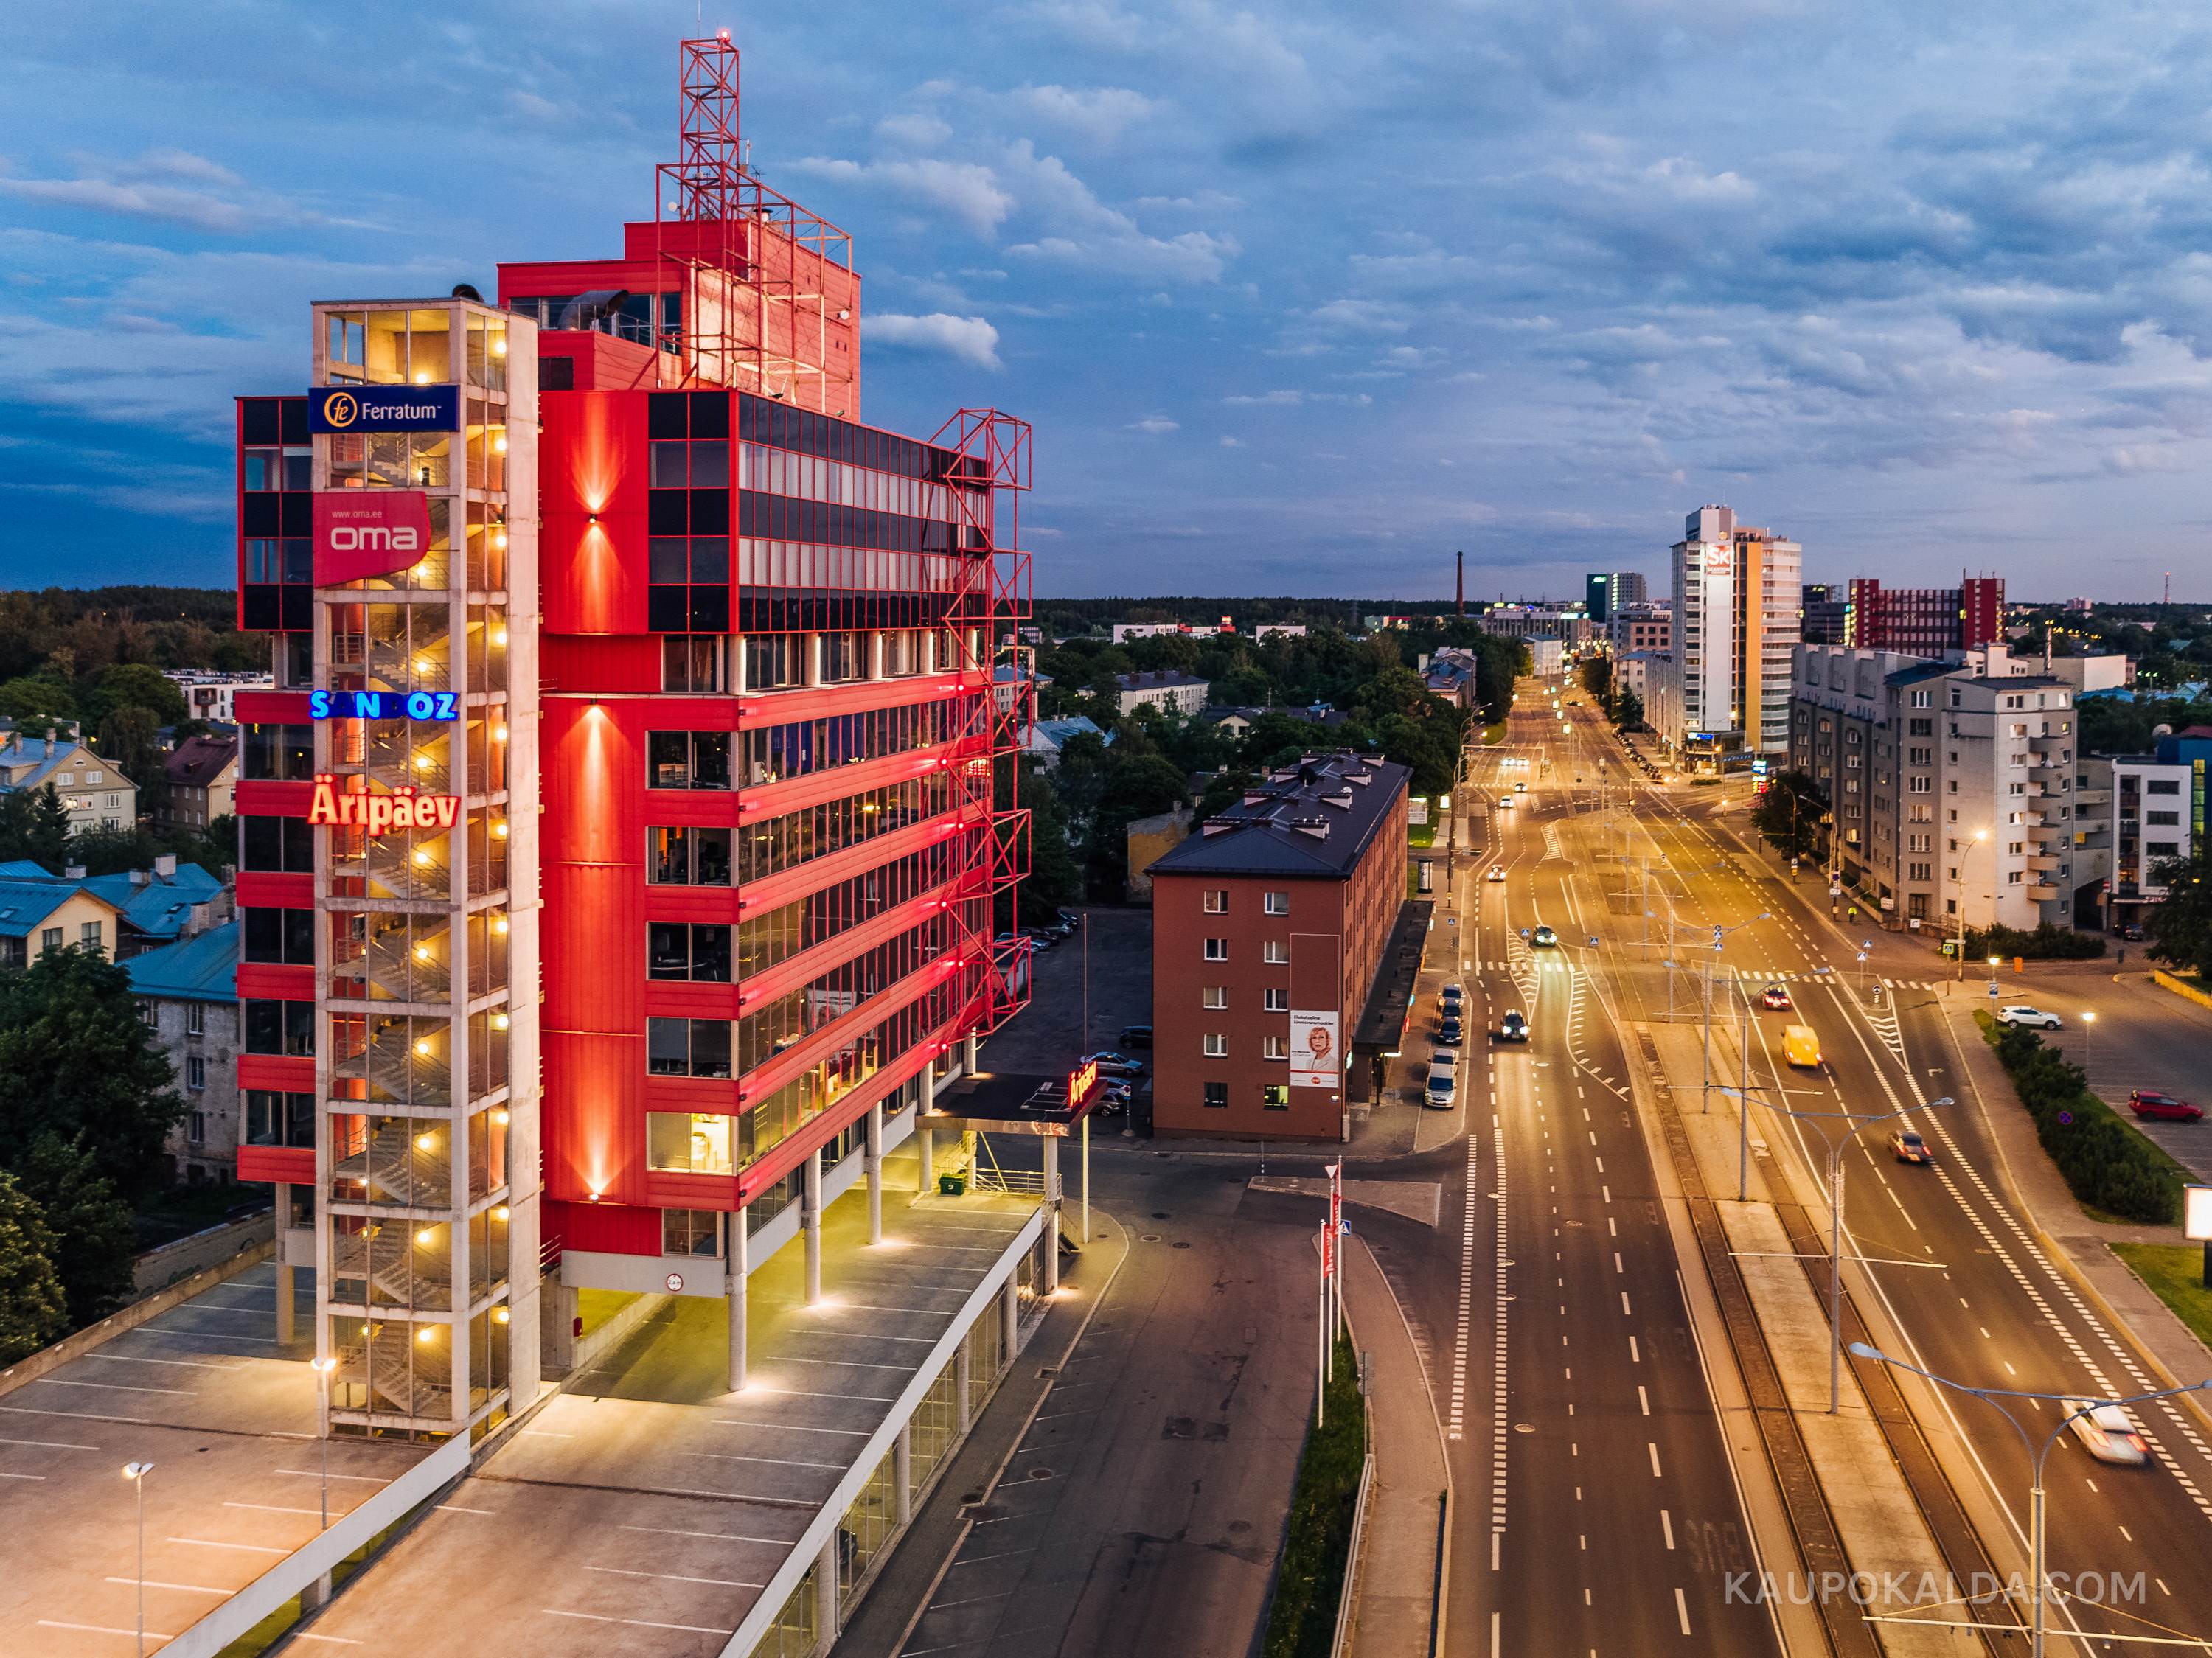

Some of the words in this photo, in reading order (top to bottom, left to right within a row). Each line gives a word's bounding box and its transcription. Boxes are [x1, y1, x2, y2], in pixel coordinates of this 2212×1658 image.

[330, 527, 417, 550] oma
[307, 773, 461, 837] Äripäev
[1069, 1062, 1096, 1108] Äripäev
